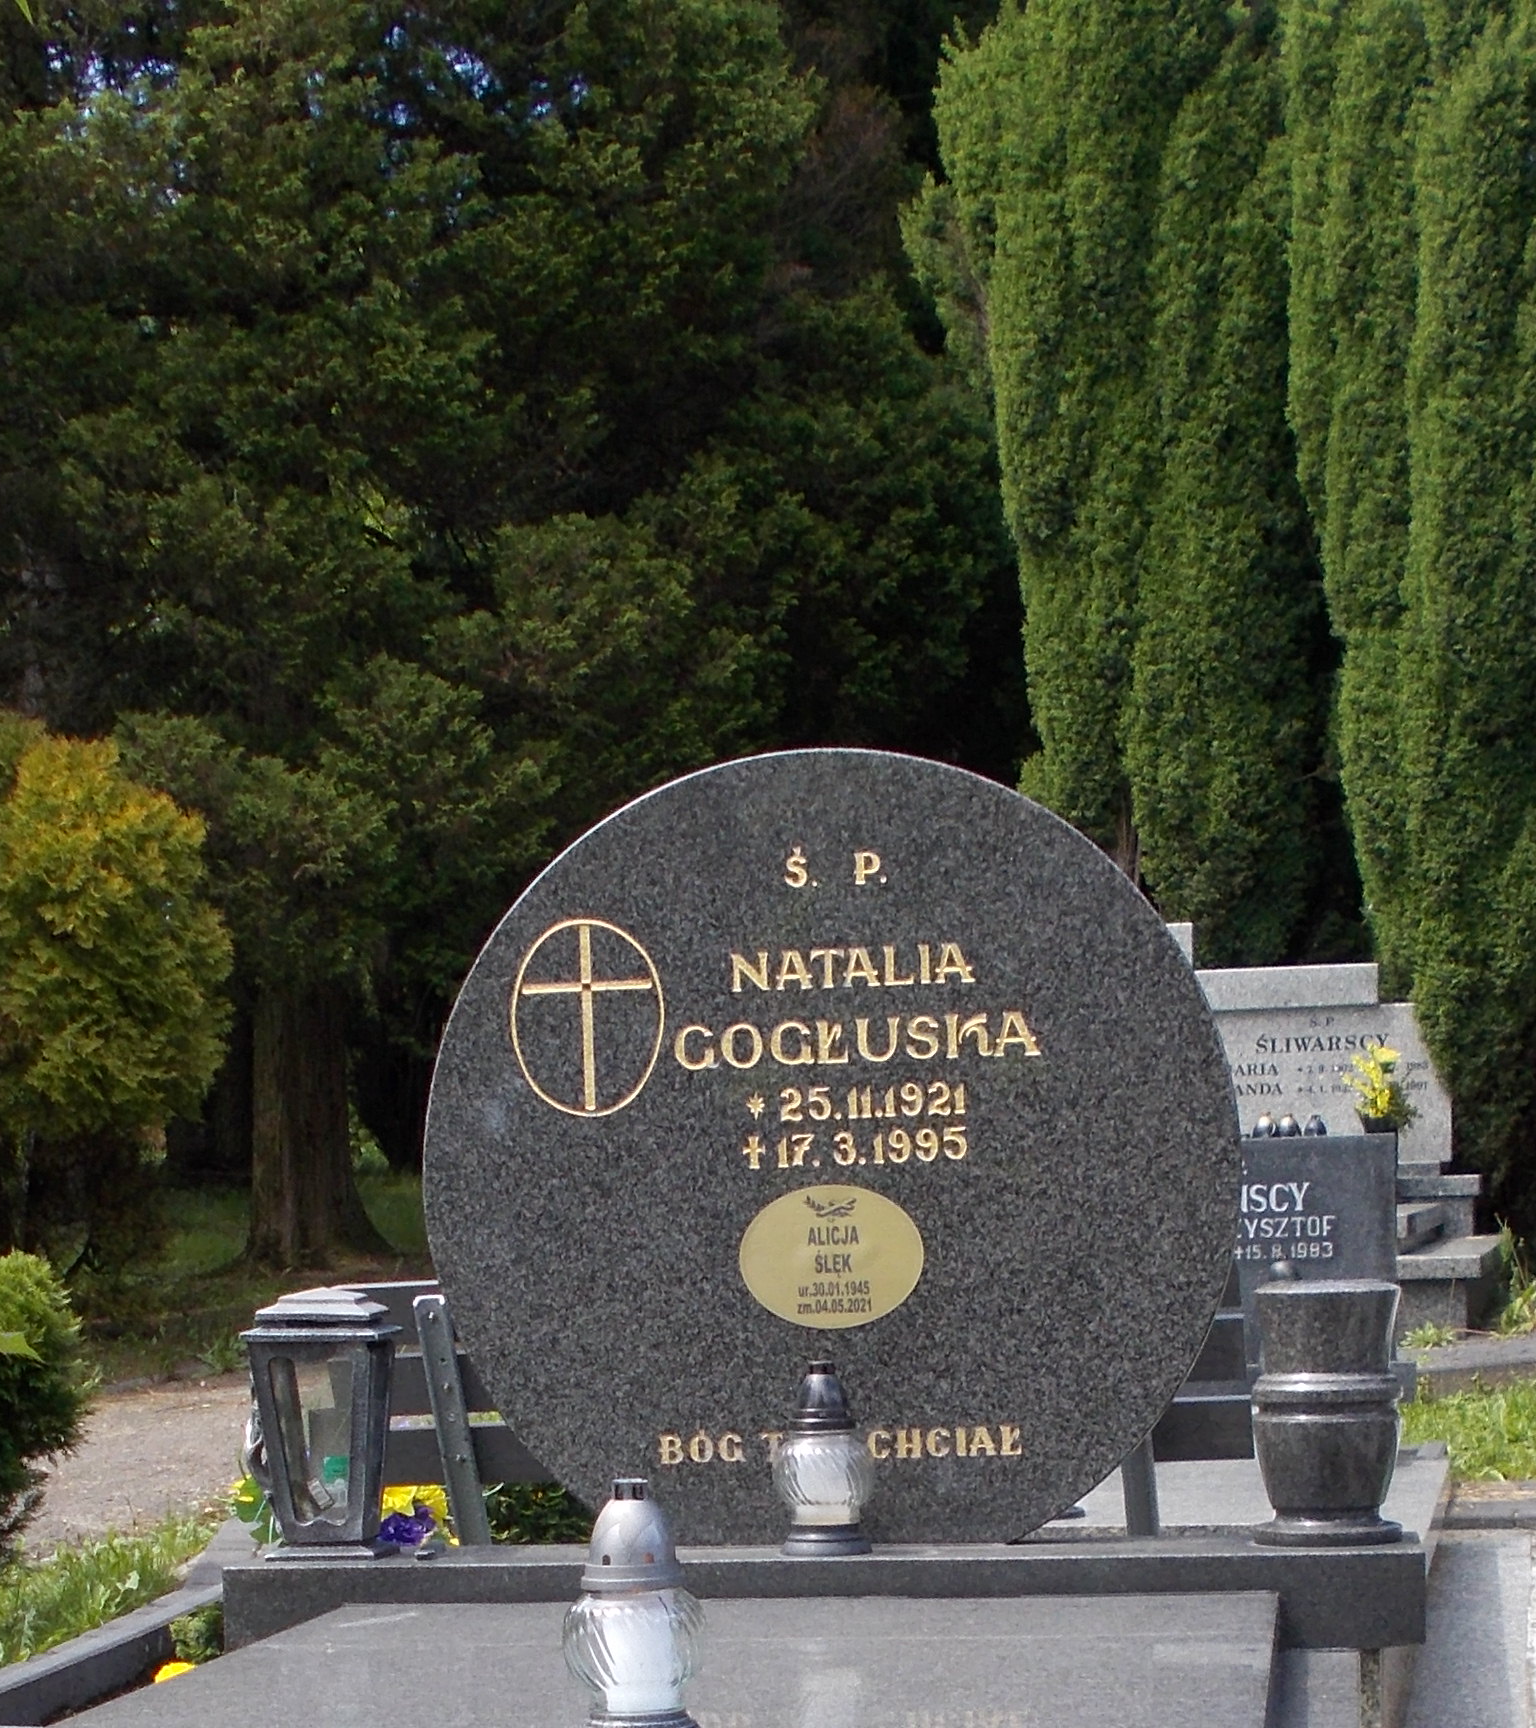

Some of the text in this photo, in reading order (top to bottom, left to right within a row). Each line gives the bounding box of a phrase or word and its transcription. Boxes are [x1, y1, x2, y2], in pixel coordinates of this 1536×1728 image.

[730, 941, 977, 993] NATALIA
[673, 1010, 1042, 1071] GOGŁUSKA
[1255, 1032, 1390, 1055] ŚLIWARSCY
[1233, 1062, 1279, 1077] ARIA
[779, 1080, 967, 1122] 25.11.1921
[1235, 1082, 1284, 1097] ANDA
[807, 1225, 860, 1247] ALICJA
[1237, 1215, 1337, 1239] YSZTOF
[814, 1250, 853, 1279] ŚLĘK
[658, 1424, 748, 1465] BÓG
[866, 1424, 1023, 1460] CHCIAŁ
